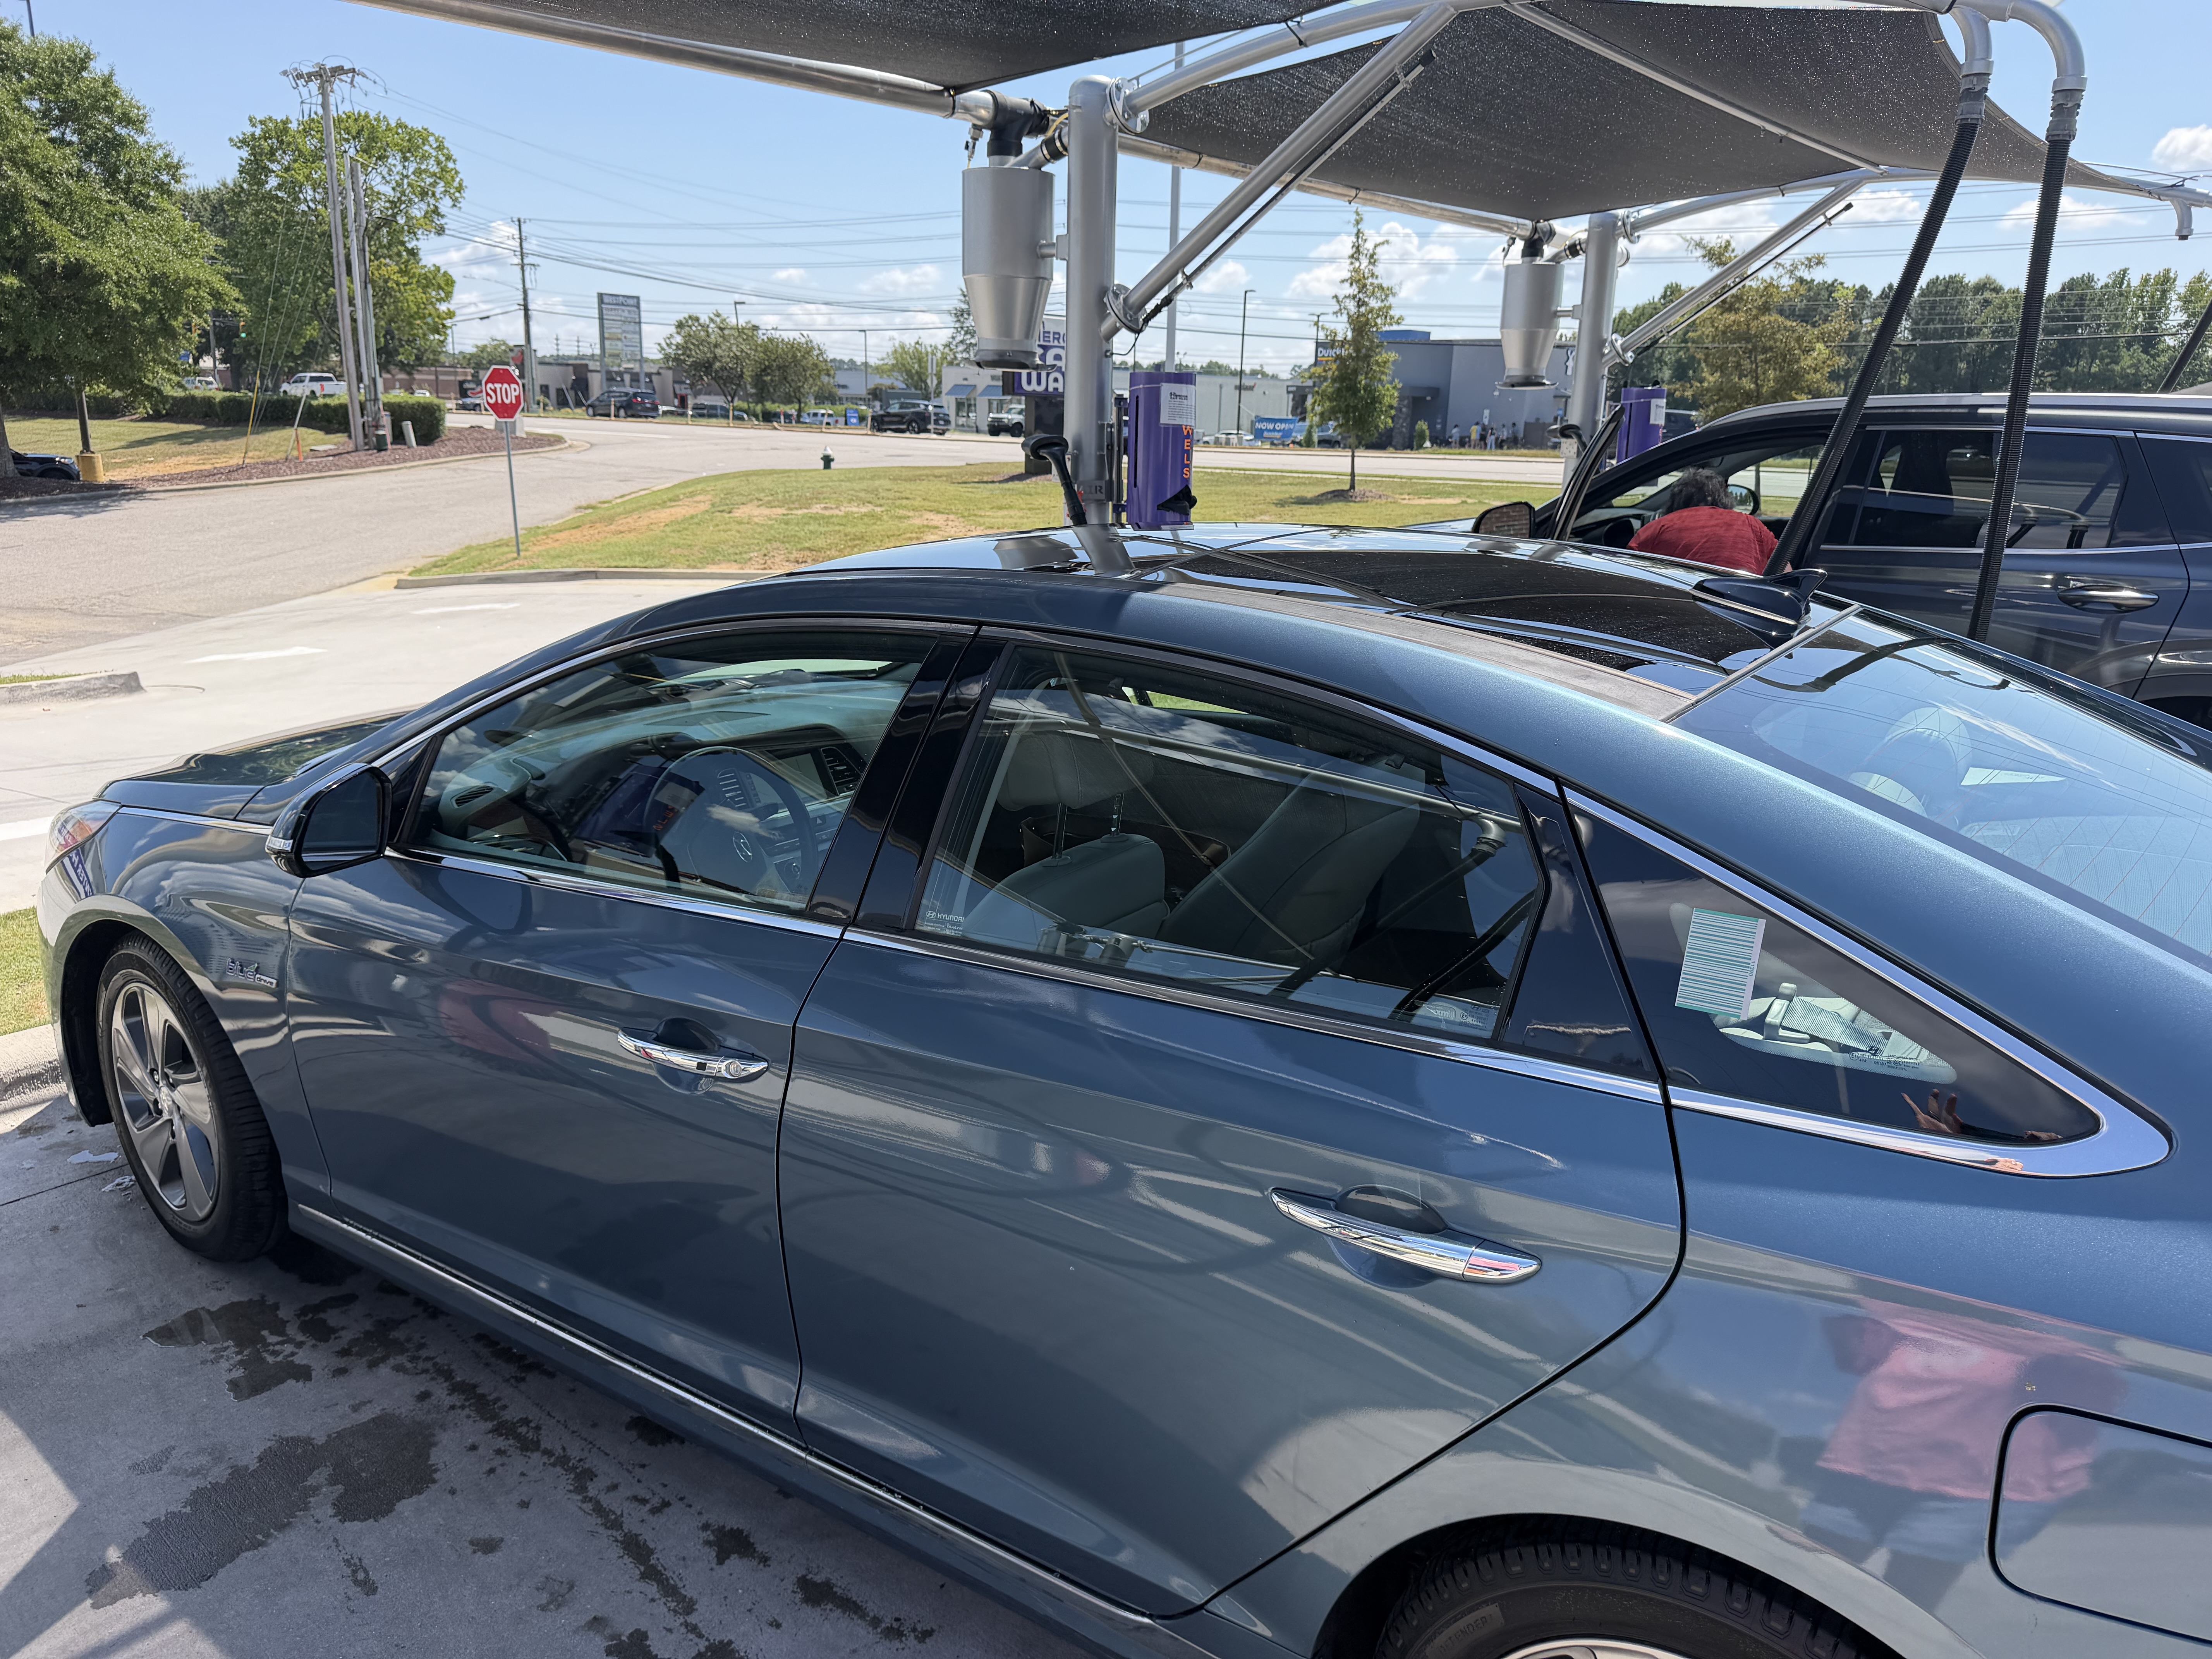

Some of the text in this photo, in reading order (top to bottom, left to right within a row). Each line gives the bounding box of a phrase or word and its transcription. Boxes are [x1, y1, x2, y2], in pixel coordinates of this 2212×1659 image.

[486, 383, 520, 404] STOP
[1255, 422, 1275, 430] NOW
[938, 913, 964, 922] HYUNDAI
[257, 976, 274, 986] drive
